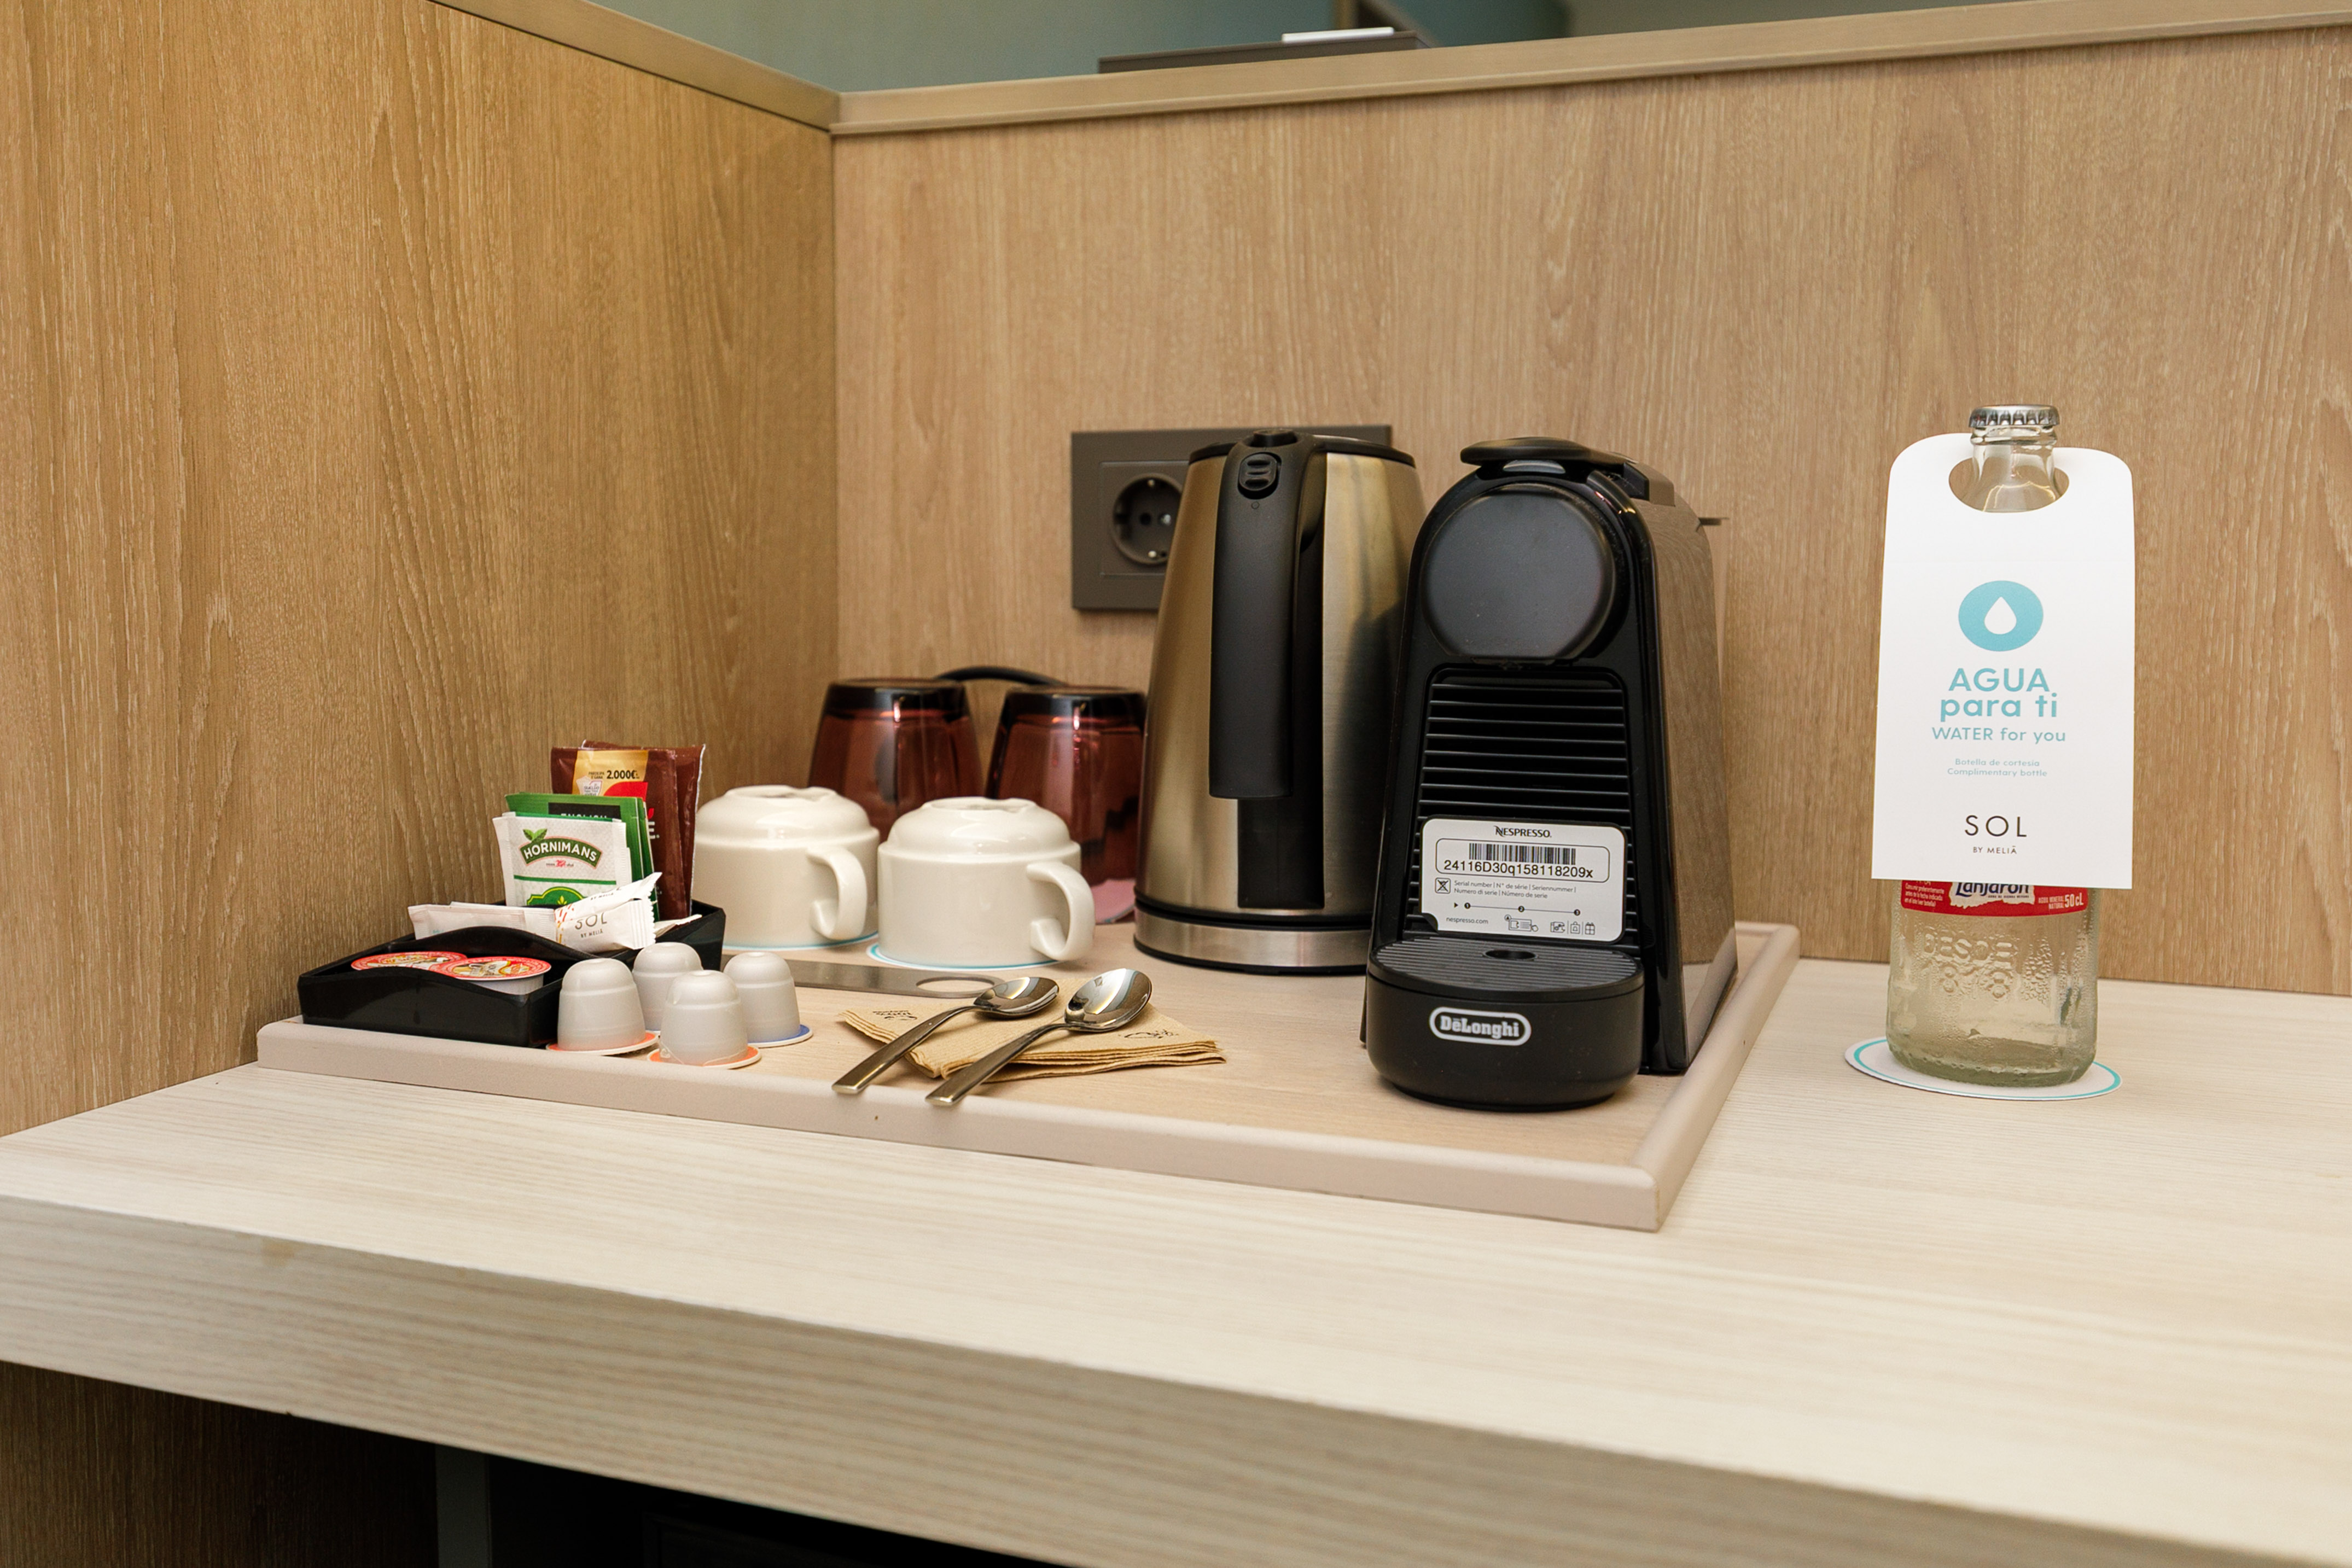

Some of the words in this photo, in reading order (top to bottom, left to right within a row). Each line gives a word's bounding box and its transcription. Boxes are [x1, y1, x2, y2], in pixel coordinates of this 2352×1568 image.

[1948, 668, 2050, 692] AGUA
[1940, 700, 2021, 722] para
[2035, 692, 2057, 717] ti
[1931, 727, 1993, 740] WATER
[2000, 727, 2027, 741] for
[2033, 732, 2066, 744] you
[1947, 768, 2017, 777] Complimentary
[1494, 826, 1551, 837] NESPRESSO
[1964, 815, 2027, 837] SOL
[523, 841, 597, 861] HORNIMANS
[1444, 859, 1593, 878] 24116D30q158118209x
[575, 912, 607, 930] SOL
